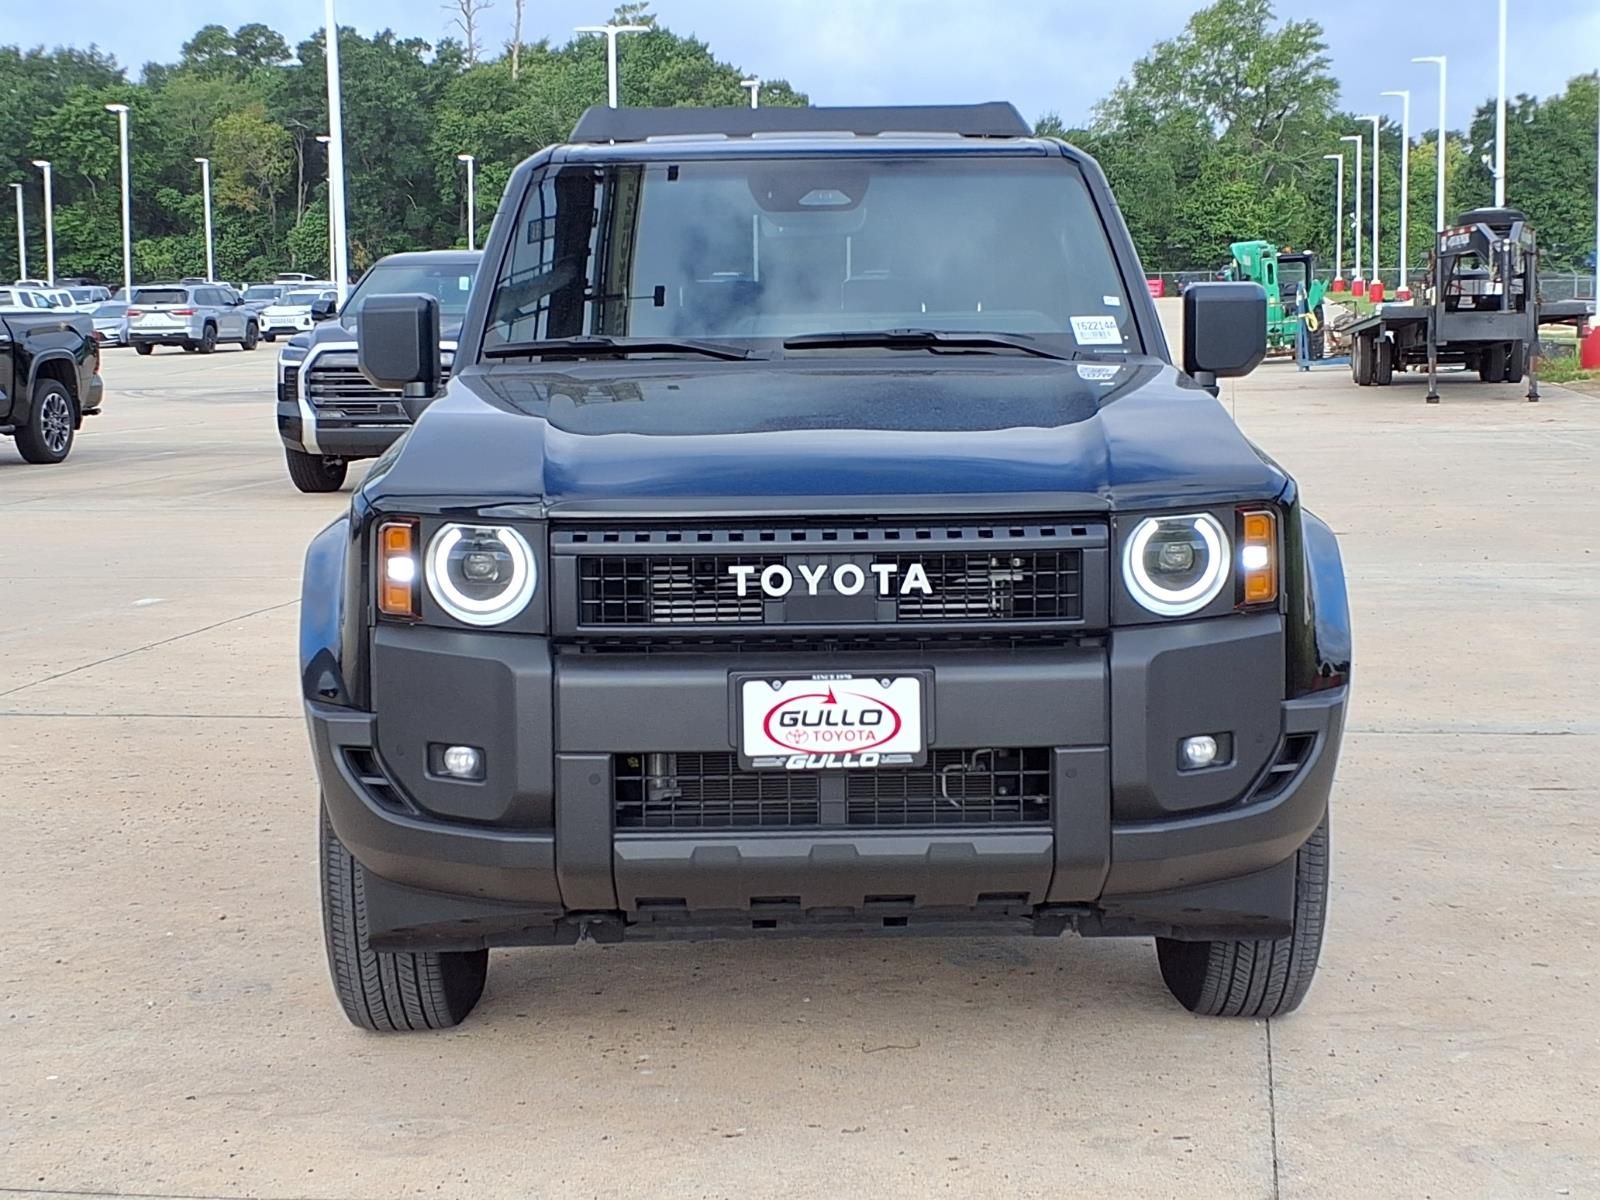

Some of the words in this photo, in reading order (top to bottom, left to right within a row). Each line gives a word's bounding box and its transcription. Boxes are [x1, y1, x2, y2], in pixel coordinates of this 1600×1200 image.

[728, 563, 933, 597] TOYOTA
[779, 709, 883, 727] GULLO
[812, 729, 877, 742] TOYOTA
[785, 752, 881, 769] GULLO
